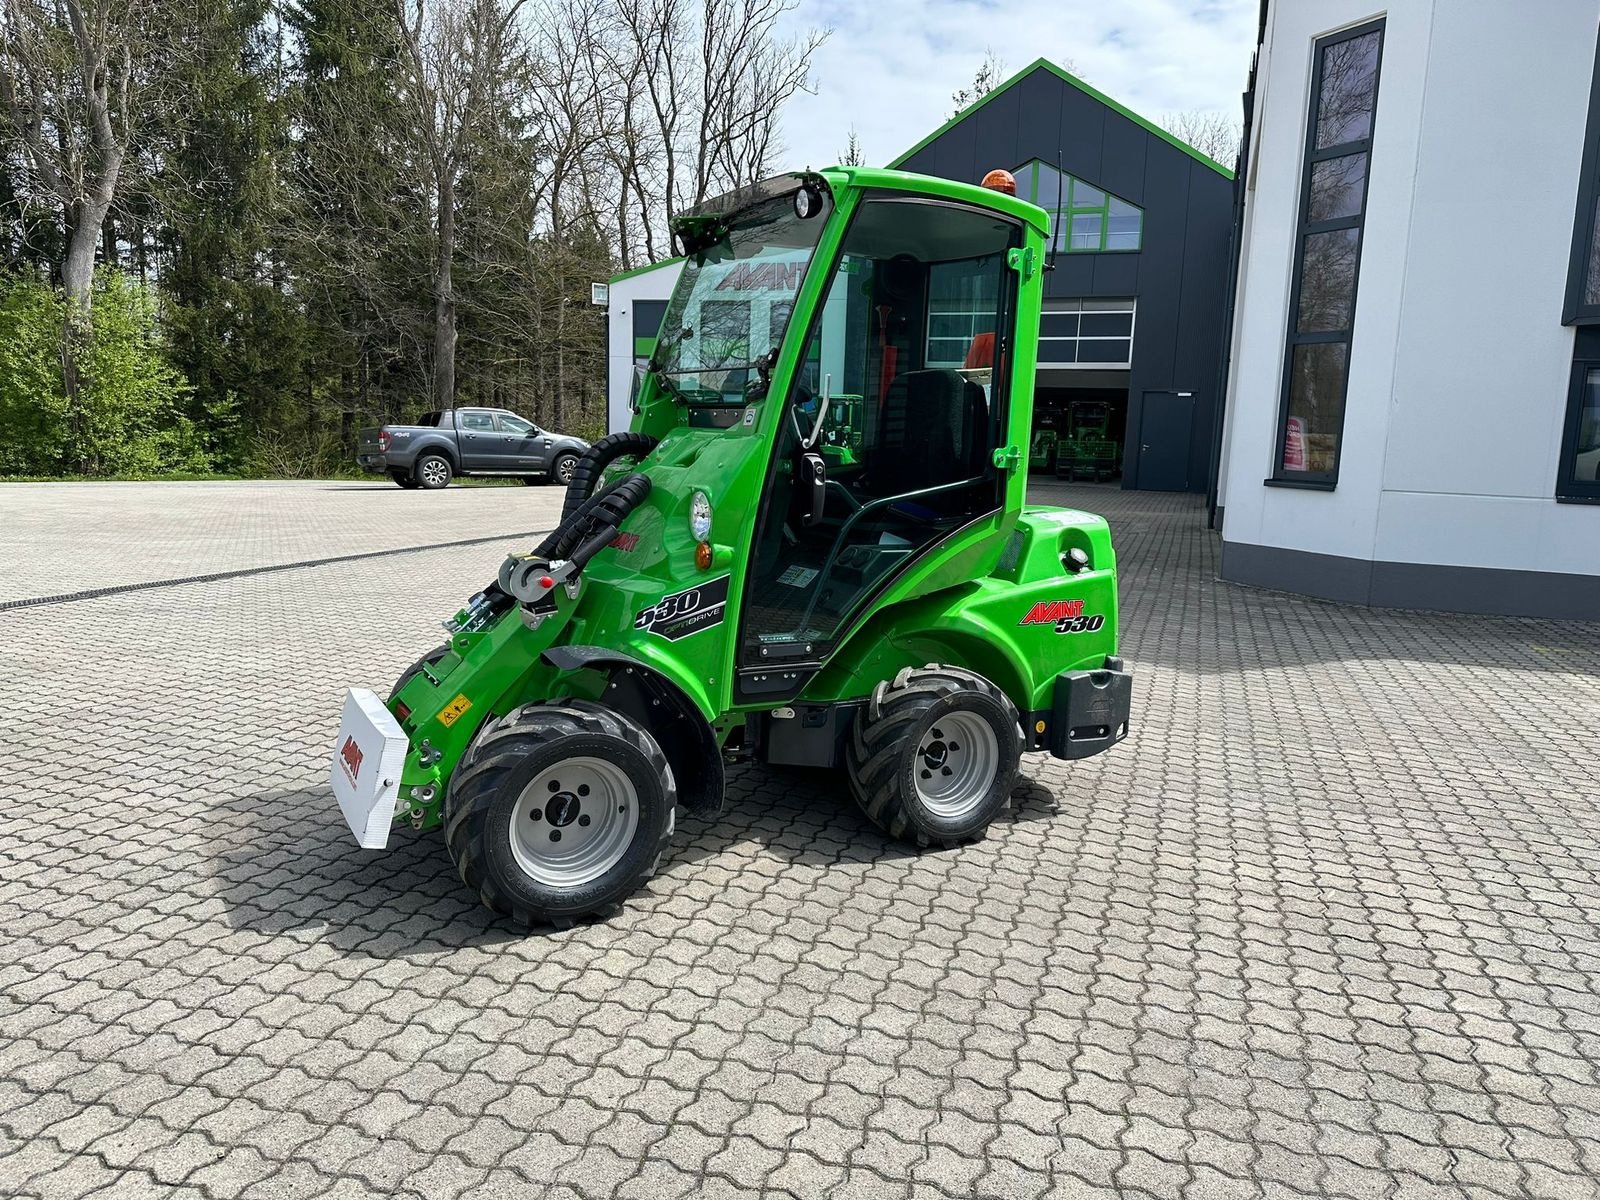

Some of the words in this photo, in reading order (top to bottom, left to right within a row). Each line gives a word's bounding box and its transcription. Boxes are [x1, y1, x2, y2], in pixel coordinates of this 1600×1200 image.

[607, 532, 641, 553] VANT
[633, 589, 701, 630] 530
[663, 607, 720, 635] OPTIDRIVE
[1018, 599, 1085, 625] AVANT
[1054, 614, 1106, 634] 530
